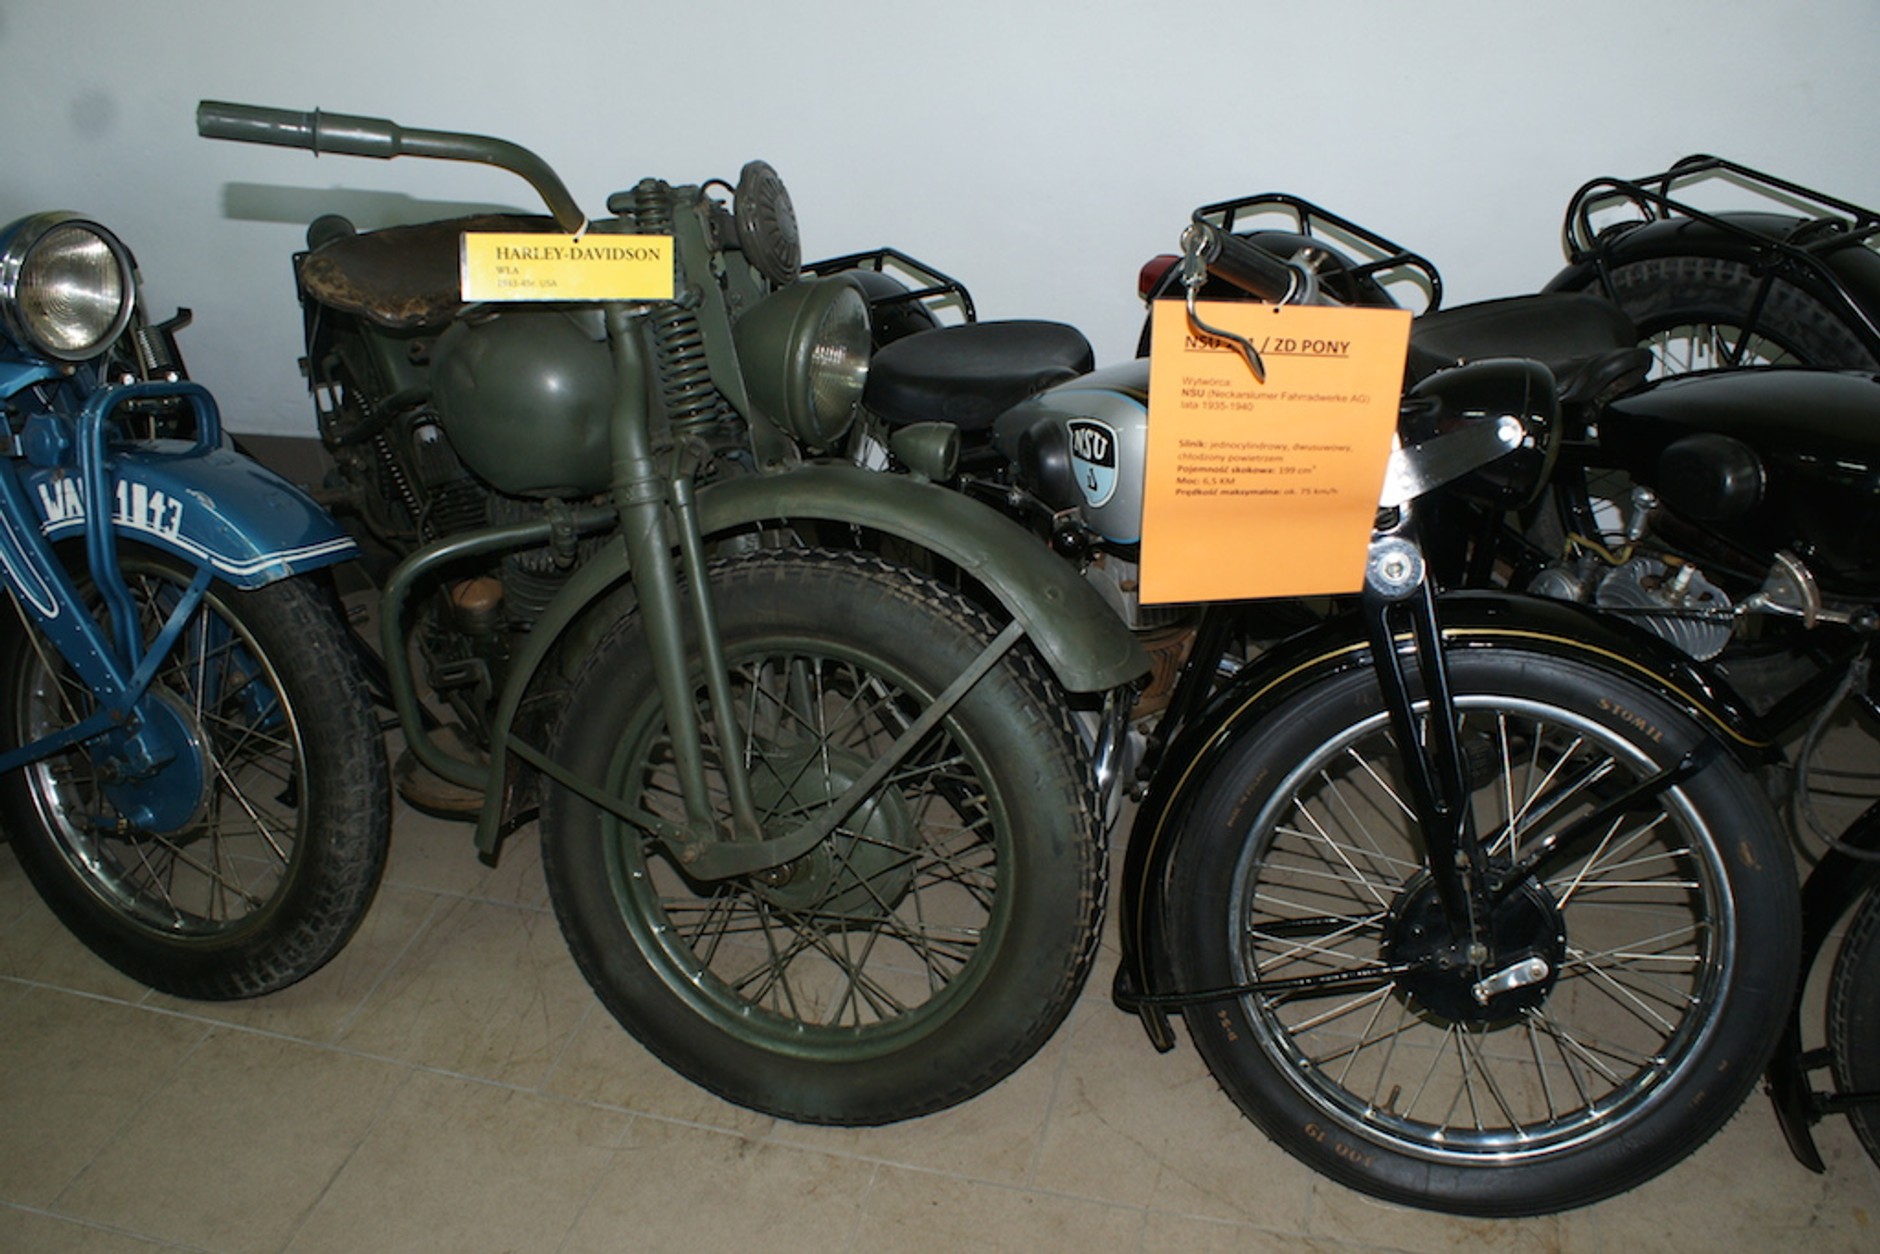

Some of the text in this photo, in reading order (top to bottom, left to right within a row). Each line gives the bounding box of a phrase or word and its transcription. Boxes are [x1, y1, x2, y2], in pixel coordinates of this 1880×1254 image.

[496, 247, 661, 262] HARLEY-DAVIDSON
[1274, 338, 1297, 352] ZD
[1301, 339, 1351, 354] PONY
[1181, 388, 1206, 398] NSU
[1180, 400, 1255, 411] lata 1935-1940
[1073, 427, 1109, 460] NSU
[1278, 466, 1297, 475] 199
[1219, 477, 1236, 485] KM
